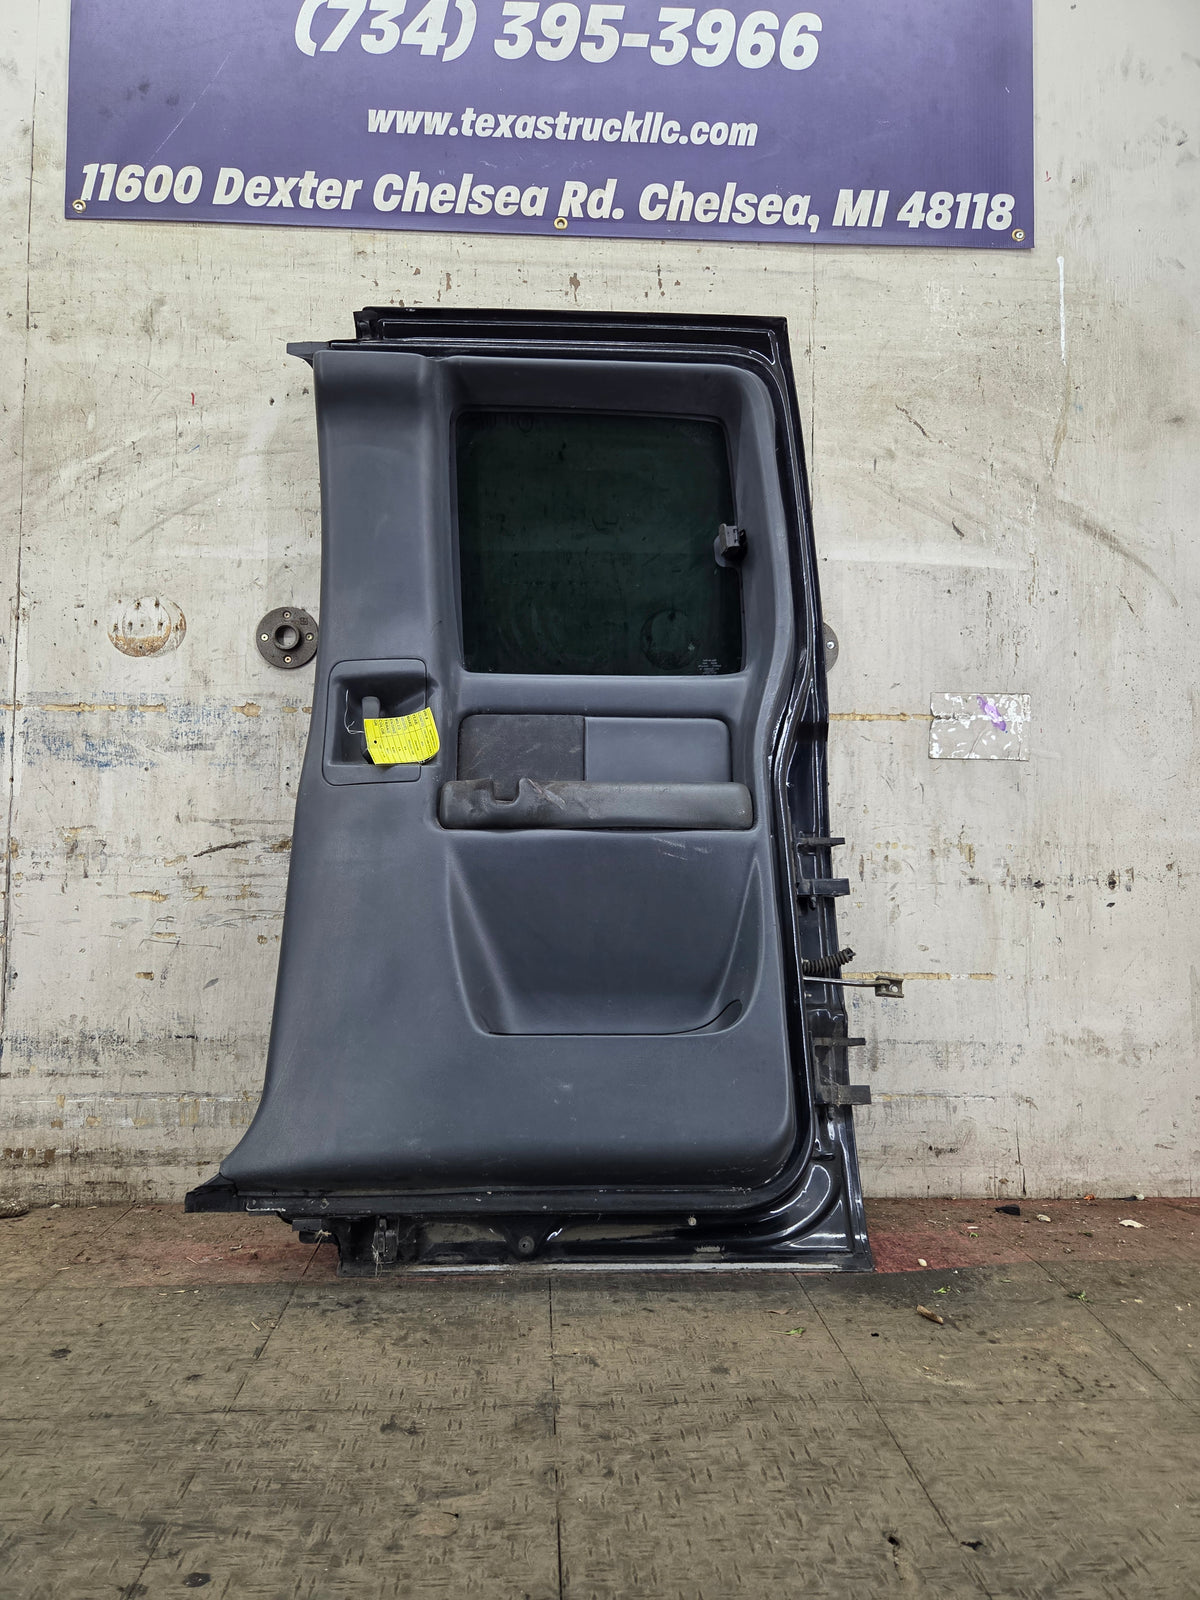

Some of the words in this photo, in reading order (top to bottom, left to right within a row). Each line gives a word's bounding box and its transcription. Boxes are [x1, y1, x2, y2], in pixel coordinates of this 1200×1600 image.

[294, 0, 478, 62] (734)
[493, 0, 823, 71] 395-3966
[367, 107, 759, 147] www.texastruckllc.com
[79, 163, 203, 204] 11600
[212, 167, 363, 211] Dexter
[372, 171, 549, 217] Chelsea
[558, 178, 625, 220] Rd.
[638, 180, 820, 233] Chelsea,
[832, 188, 890, 228] MI
[897, 190, 1015, 231] 48118
